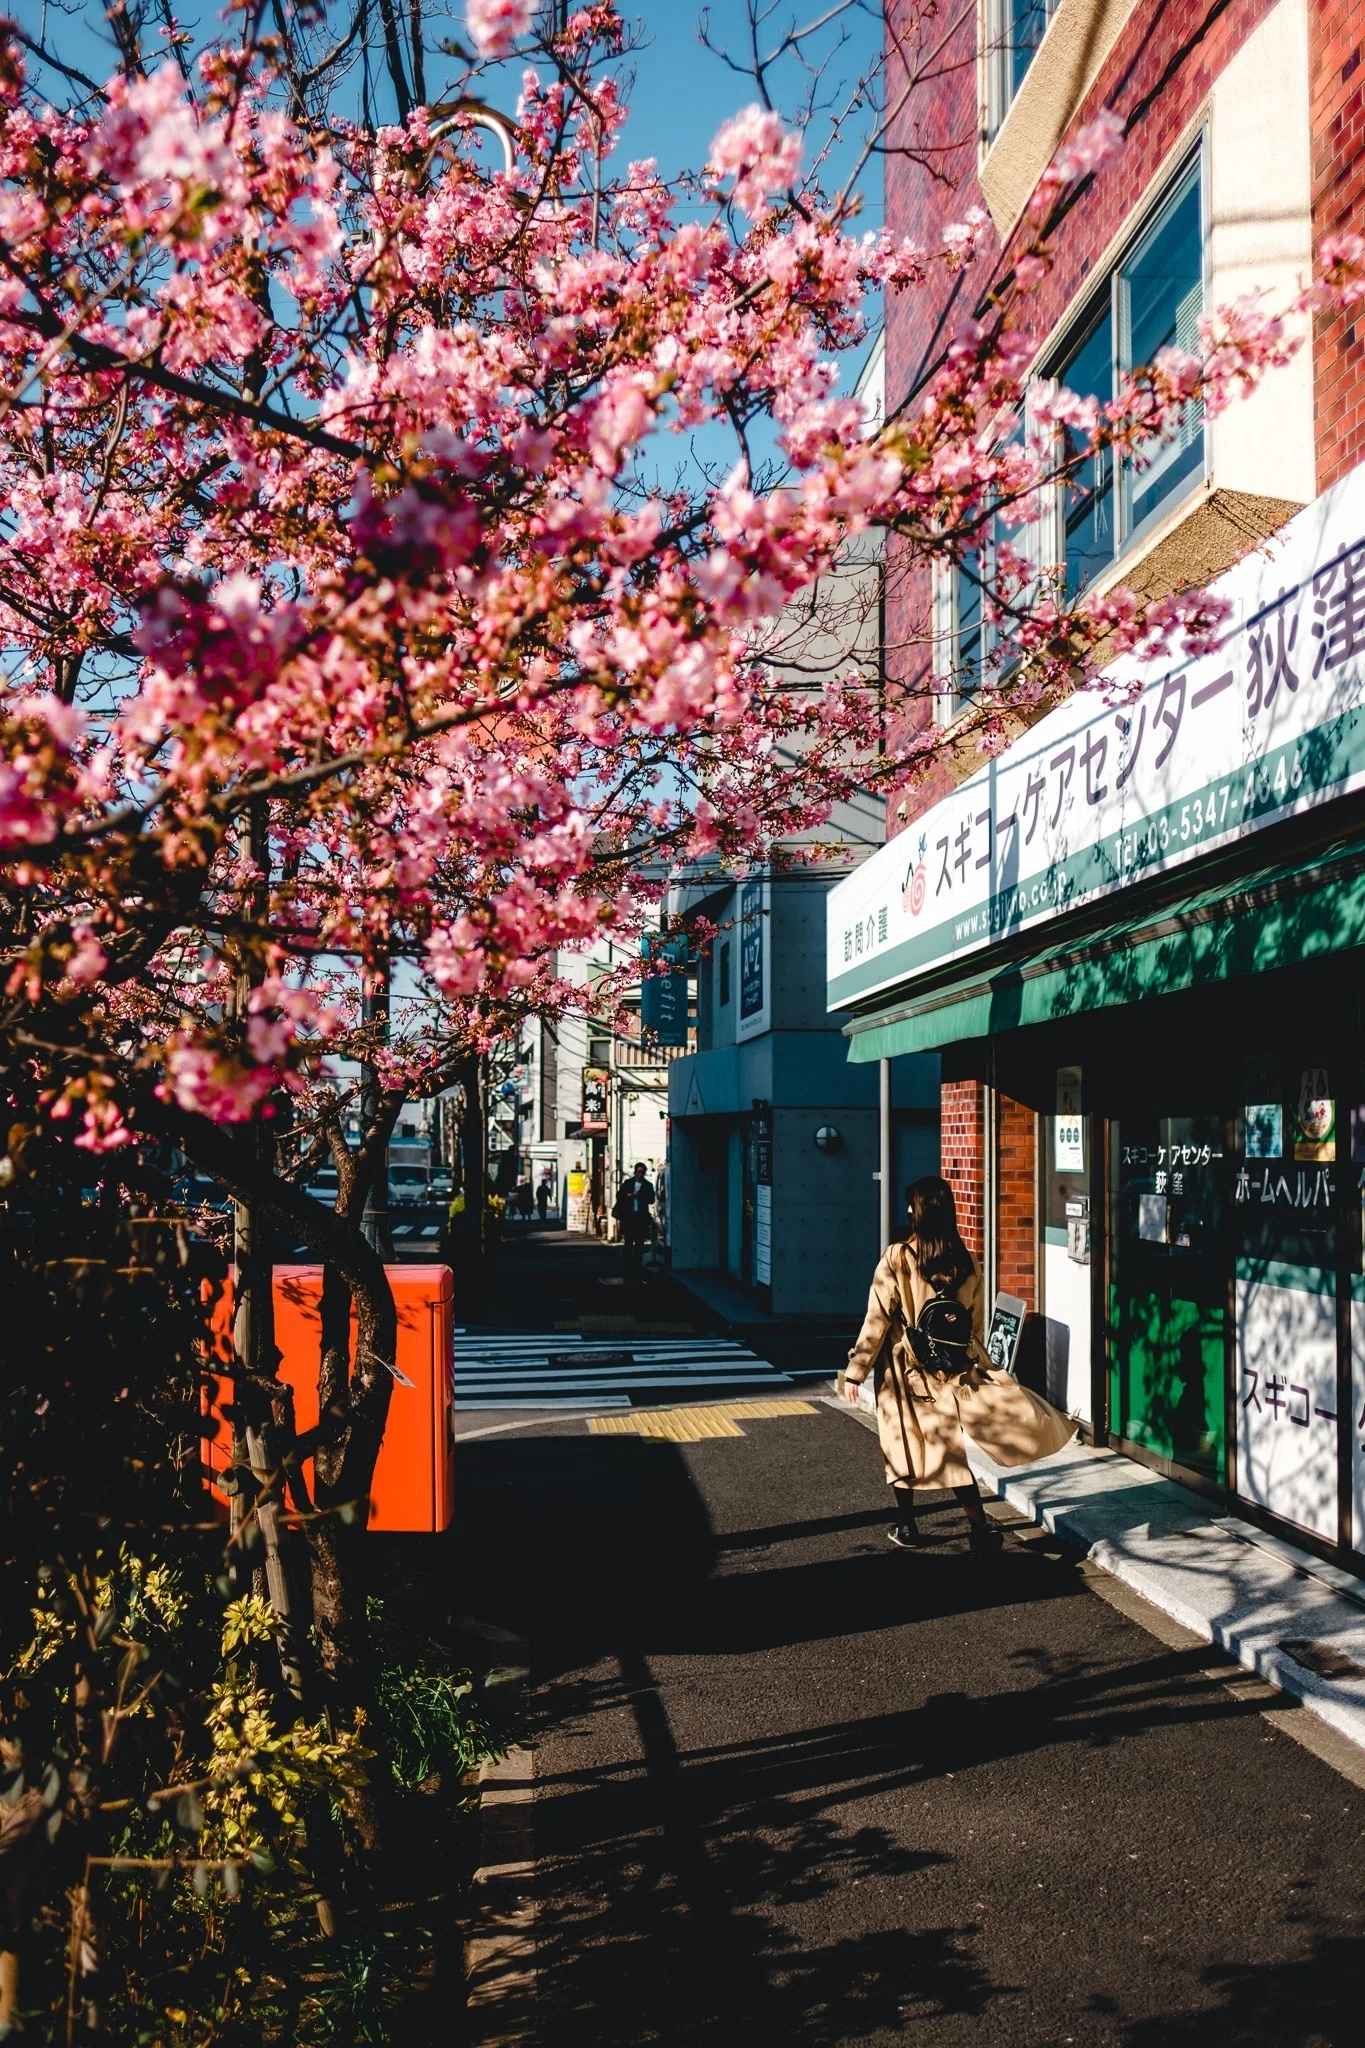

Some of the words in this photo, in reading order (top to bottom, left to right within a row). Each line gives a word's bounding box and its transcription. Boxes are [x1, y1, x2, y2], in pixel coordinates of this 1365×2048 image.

[844, 904, 888, 962] 訪問介護
[660, 952, 676, 1022] Eefit
[1155, 1170, 1184, 1195] 荻窪
[1242, 1367, 1338, 1428] スギコー
